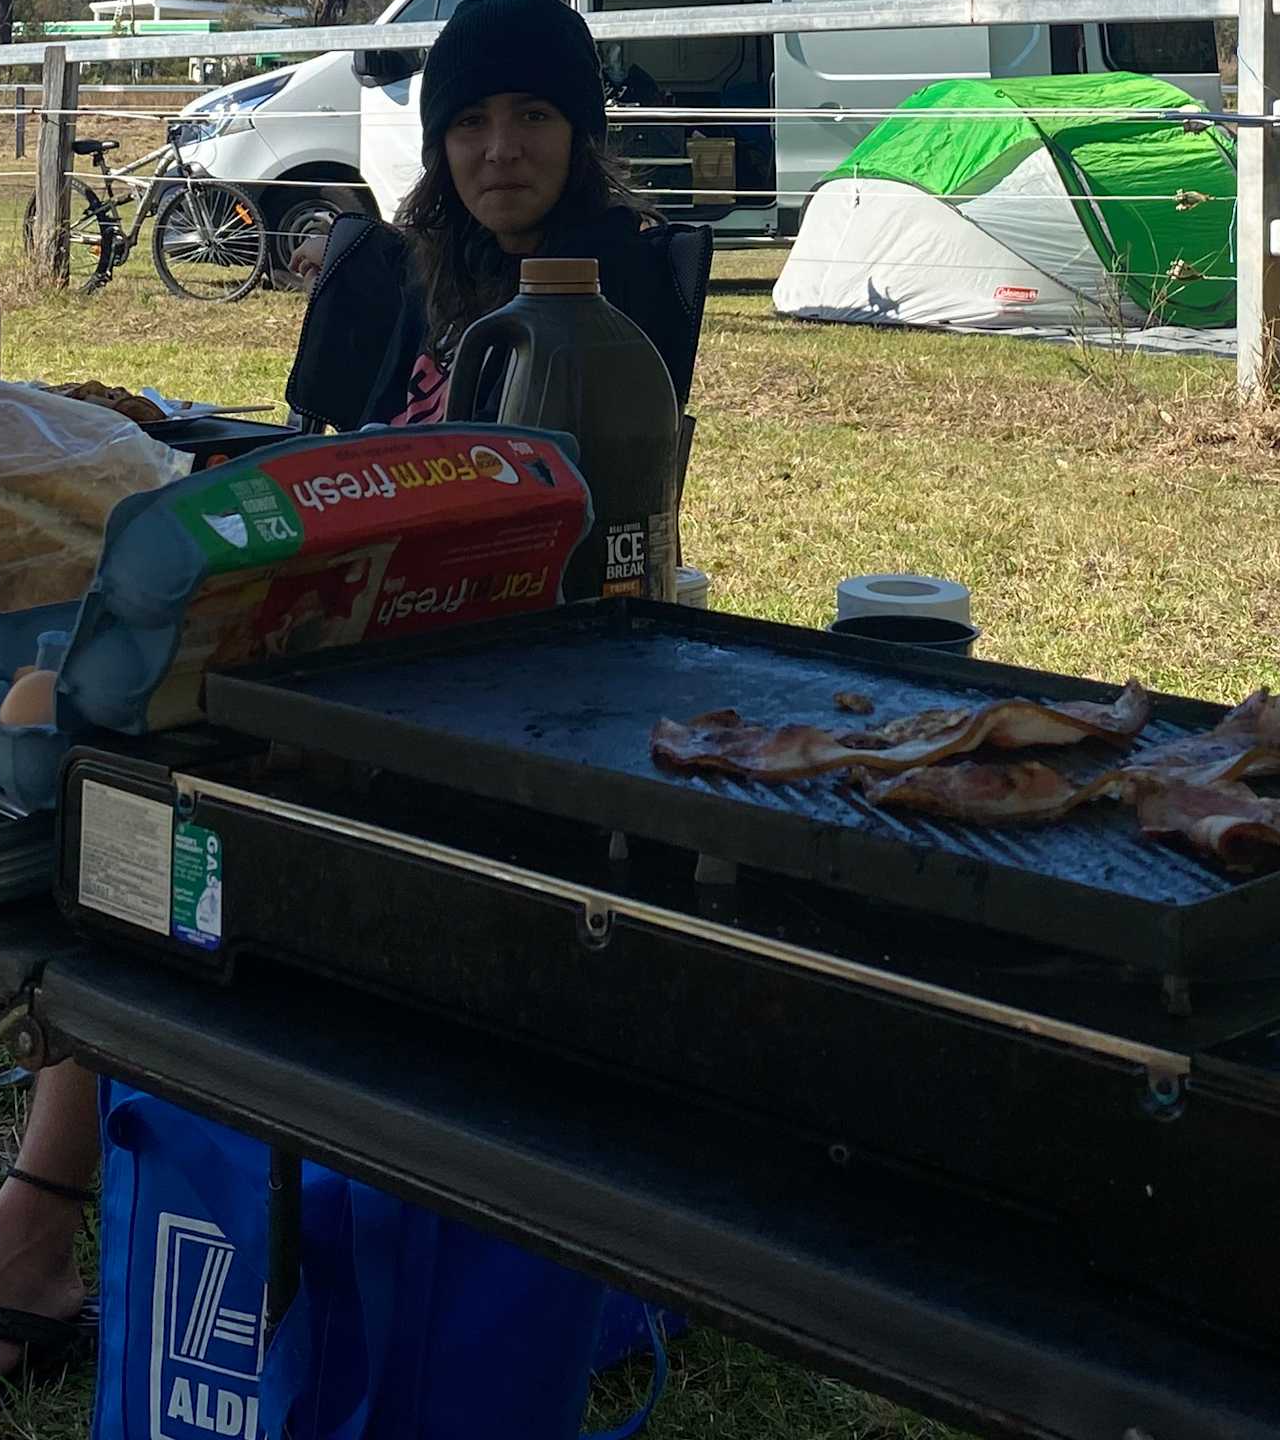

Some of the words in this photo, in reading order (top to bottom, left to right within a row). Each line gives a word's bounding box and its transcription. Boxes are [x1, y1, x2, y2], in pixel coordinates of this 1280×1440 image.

[606, 532, 645, 565] ICE
[606, 561, 645, 580] BREAK
[206, 835, 219, 887] GAS
[167, 1376, 259, 1440] ALDI
